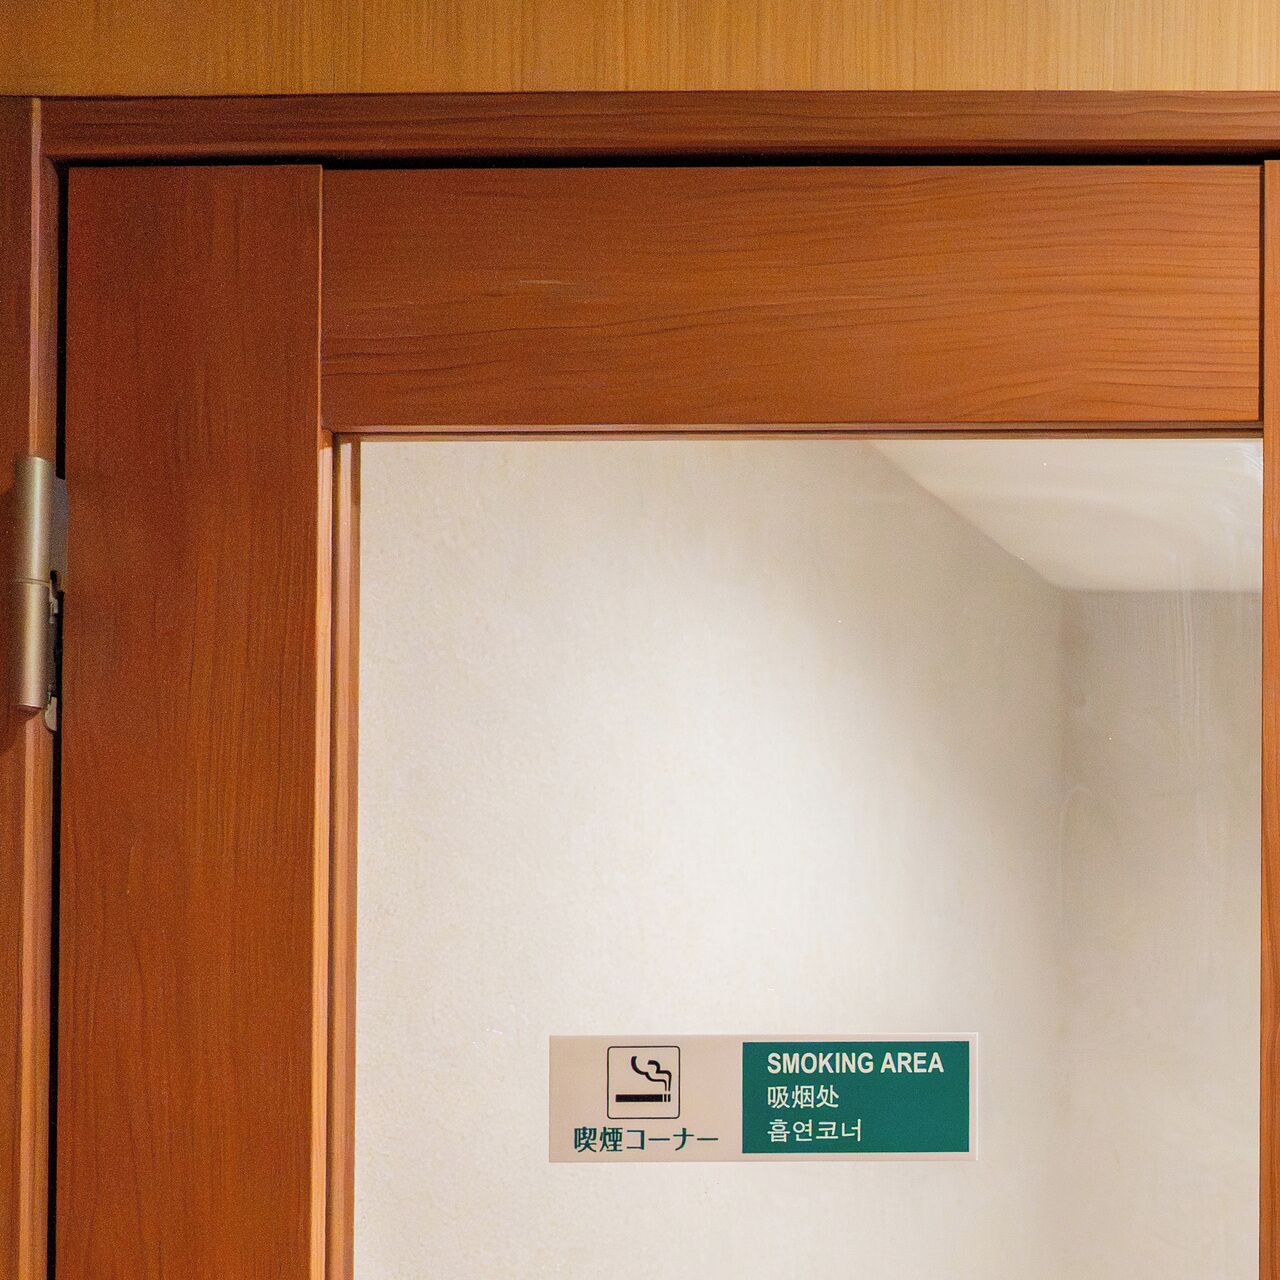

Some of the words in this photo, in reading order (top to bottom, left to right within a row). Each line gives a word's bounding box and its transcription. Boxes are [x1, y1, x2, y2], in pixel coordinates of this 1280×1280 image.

[767, 1051, 874, 1074] SMOKING
[880, 1051, 945, 1073] AREA
[767, 1084, 840, 1109] 吸烟处
[574, 1126, 719, 1153] 喫煙コーナー
[767, 1118, 862, 1143] 흡연코너
